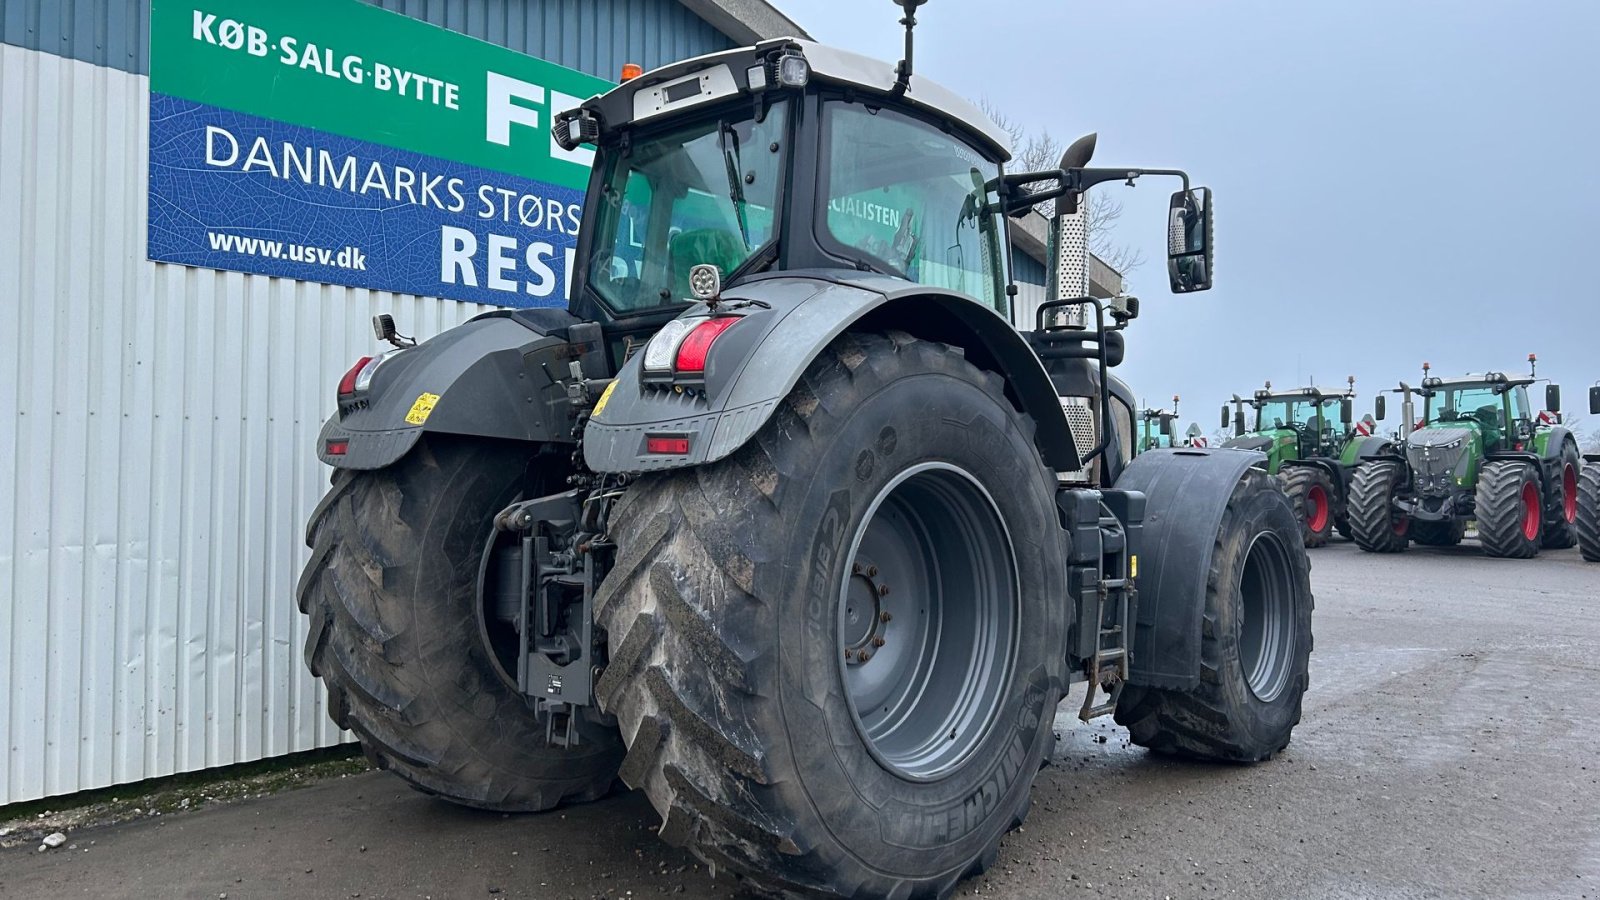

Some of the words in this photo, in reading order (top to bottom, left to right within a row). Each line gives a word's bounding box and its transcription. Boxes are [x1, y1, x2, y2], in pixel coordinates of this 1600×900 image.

[205, 125, 465, 213] DANMARKS
[828, 197, 899, 228] CIALISTEN
[208, 230, 366, 271] www.usv.dk
[440, 225, 576, 300] RES
